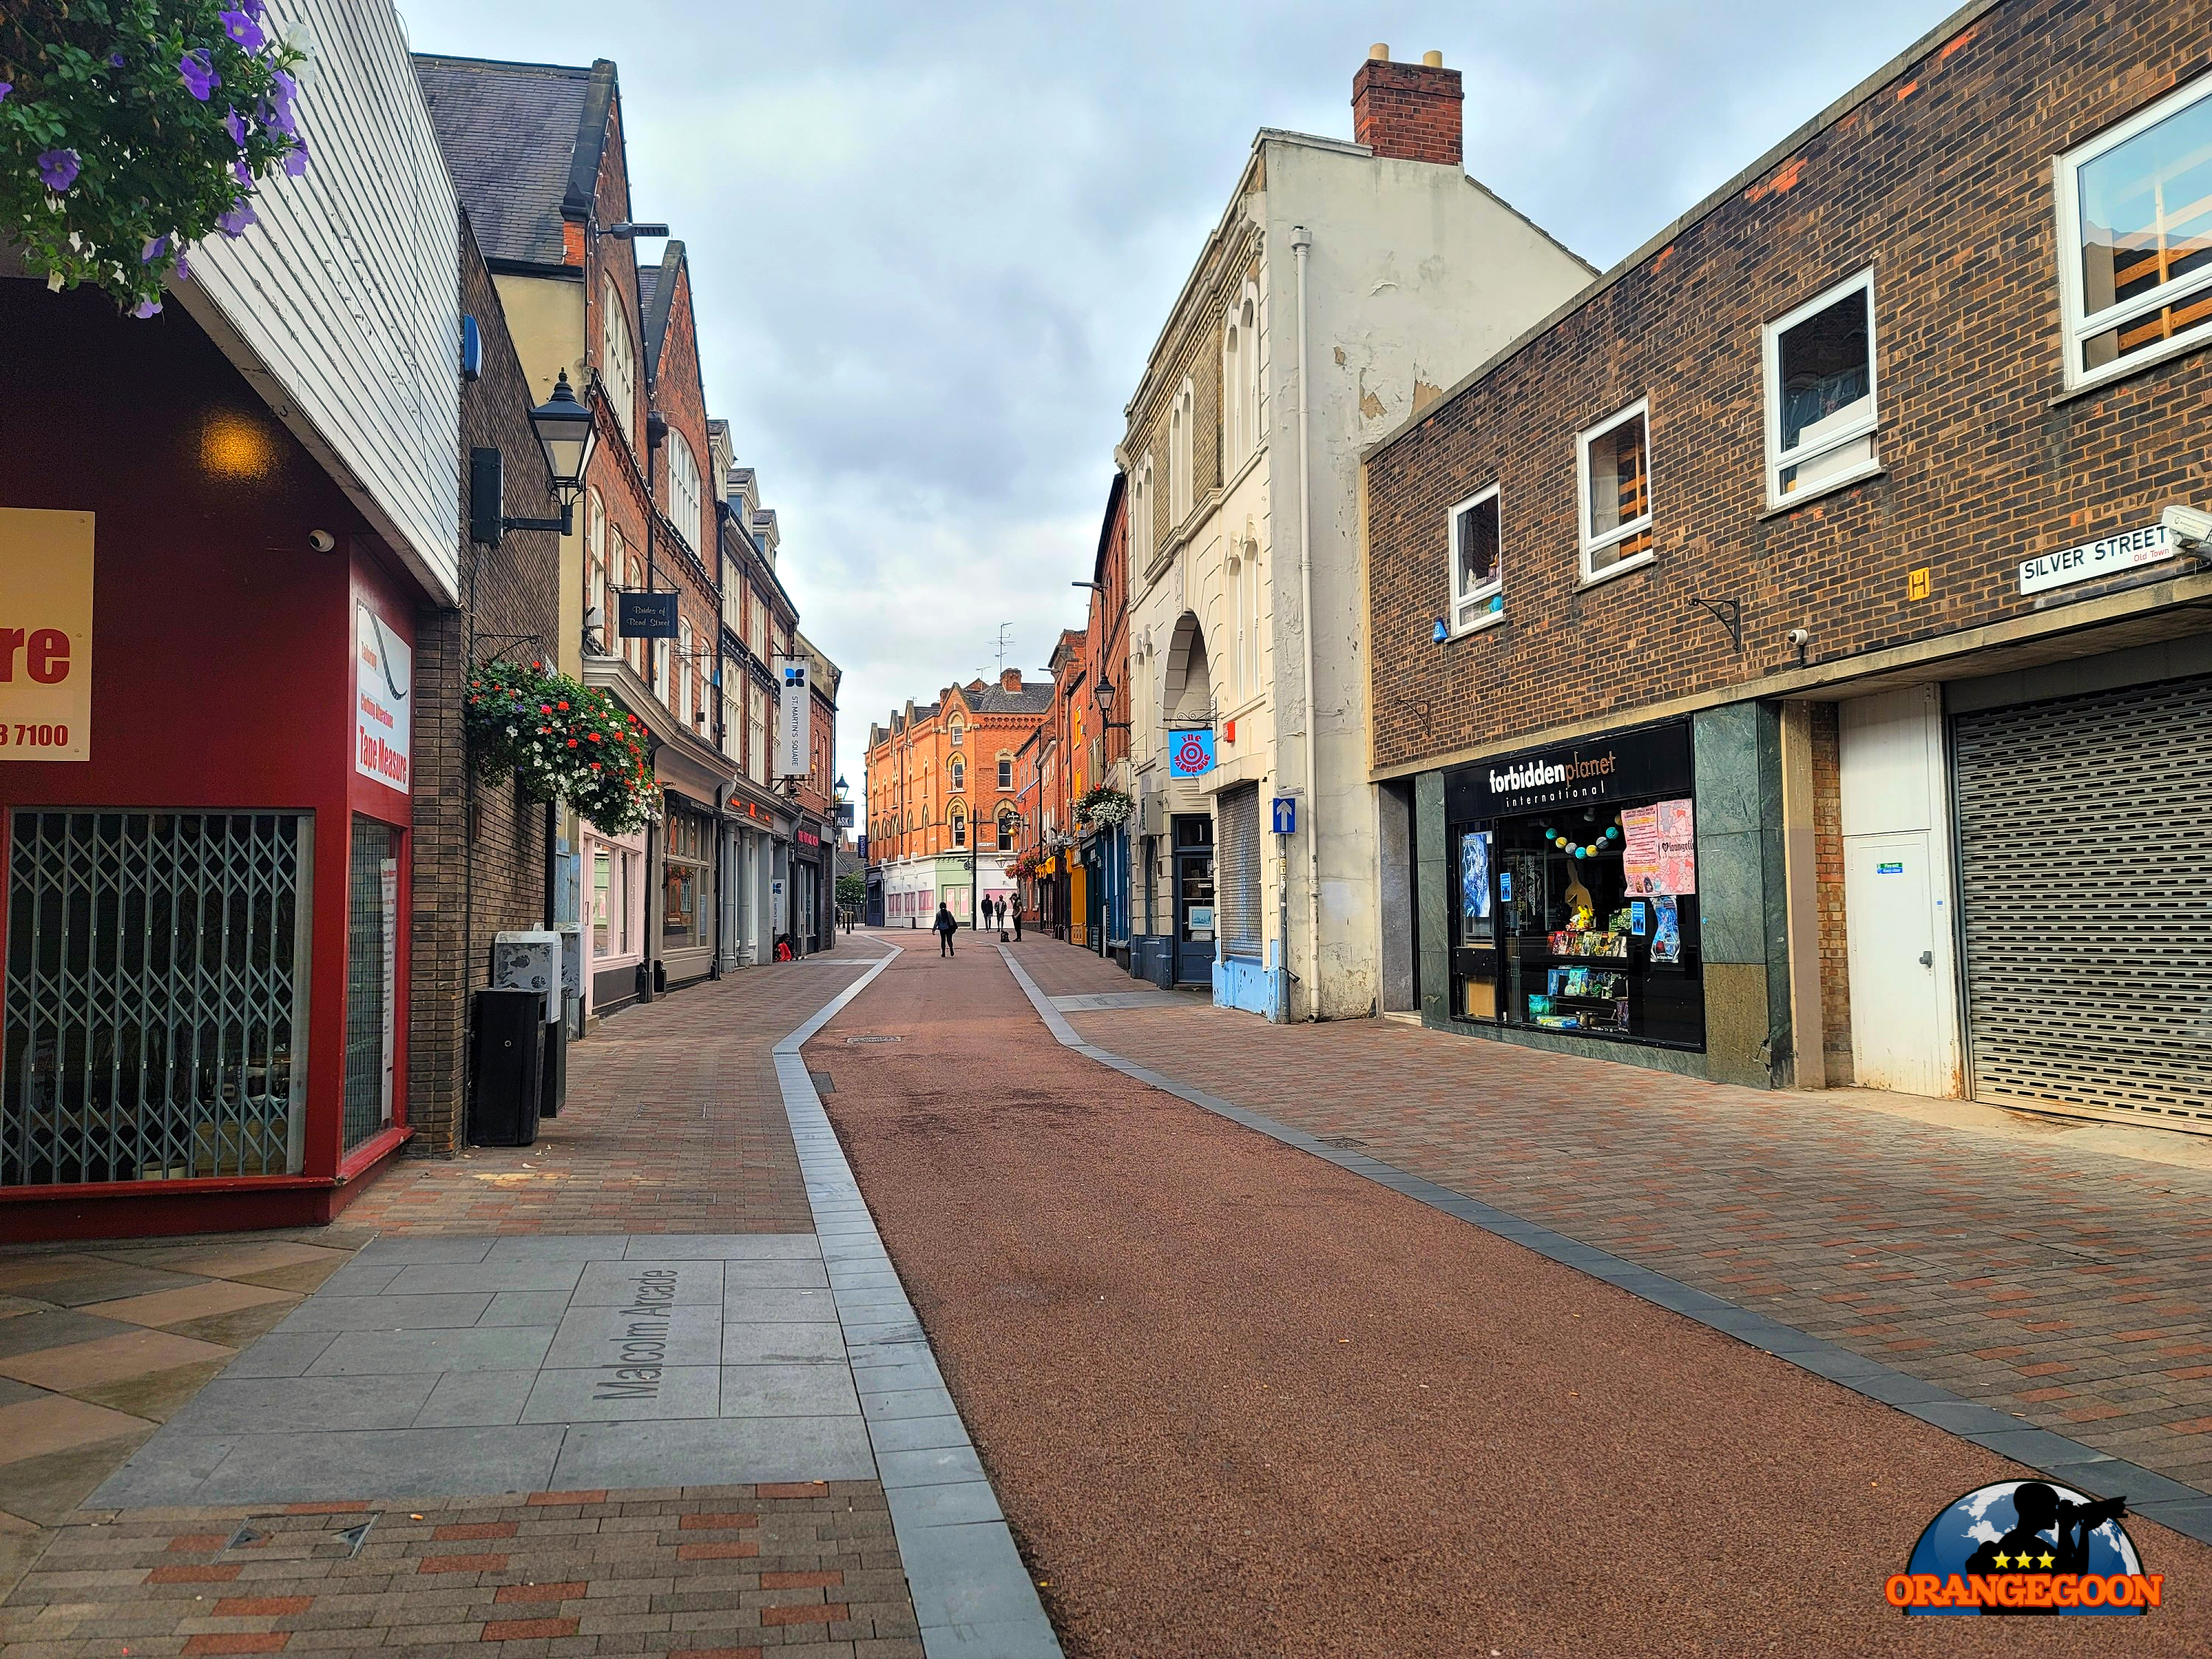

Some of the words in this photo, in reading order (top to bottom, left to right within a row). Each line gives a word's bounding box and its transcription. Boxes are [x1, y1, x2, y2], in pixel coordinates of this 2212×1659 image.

[2025, 549, 2084, 580] SILVER
[2095, 525, 2168, 560] STREET
[2134, 552, 2147, 562] Old
[2150, 548, 2169, 558] Town
[626, 617, 647, 626] Bond
[650, 618, 670, 627] Street
[632, 605, 656, 614] Brides
[658, 607, 666, 616] of
[14, 724, 69, 747] 7100
[360, 725, 378, 771] Tape
[378, 737, 407, 785] Measure
[1506, 779, 1604, 808] international
[837, 816, 849, 827] ASK
[618, 1270, 678, 1318] Arcade
[592, 1322, 669, 1401] Malcolm
